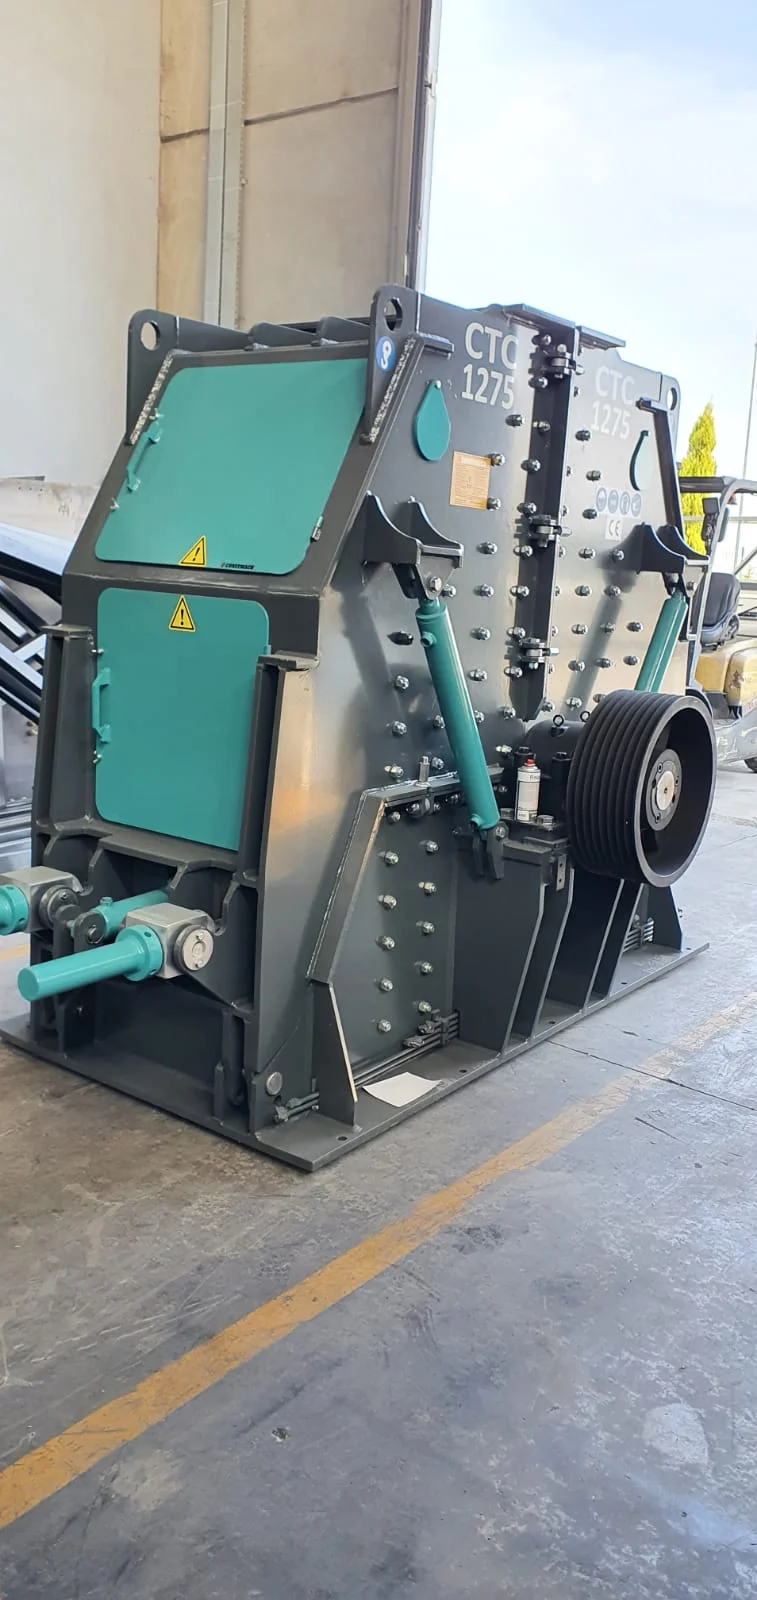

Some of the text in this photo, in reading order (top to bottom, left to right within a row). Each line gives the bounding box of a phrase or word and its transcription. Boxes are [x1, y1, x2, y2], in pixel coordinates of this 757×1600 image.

[464, 322, 518, 370] CTC
[461, 363, 516, 410] 1275
[594, 366, 636, 406] CTC
[589, 400, 631, 439] 1275
